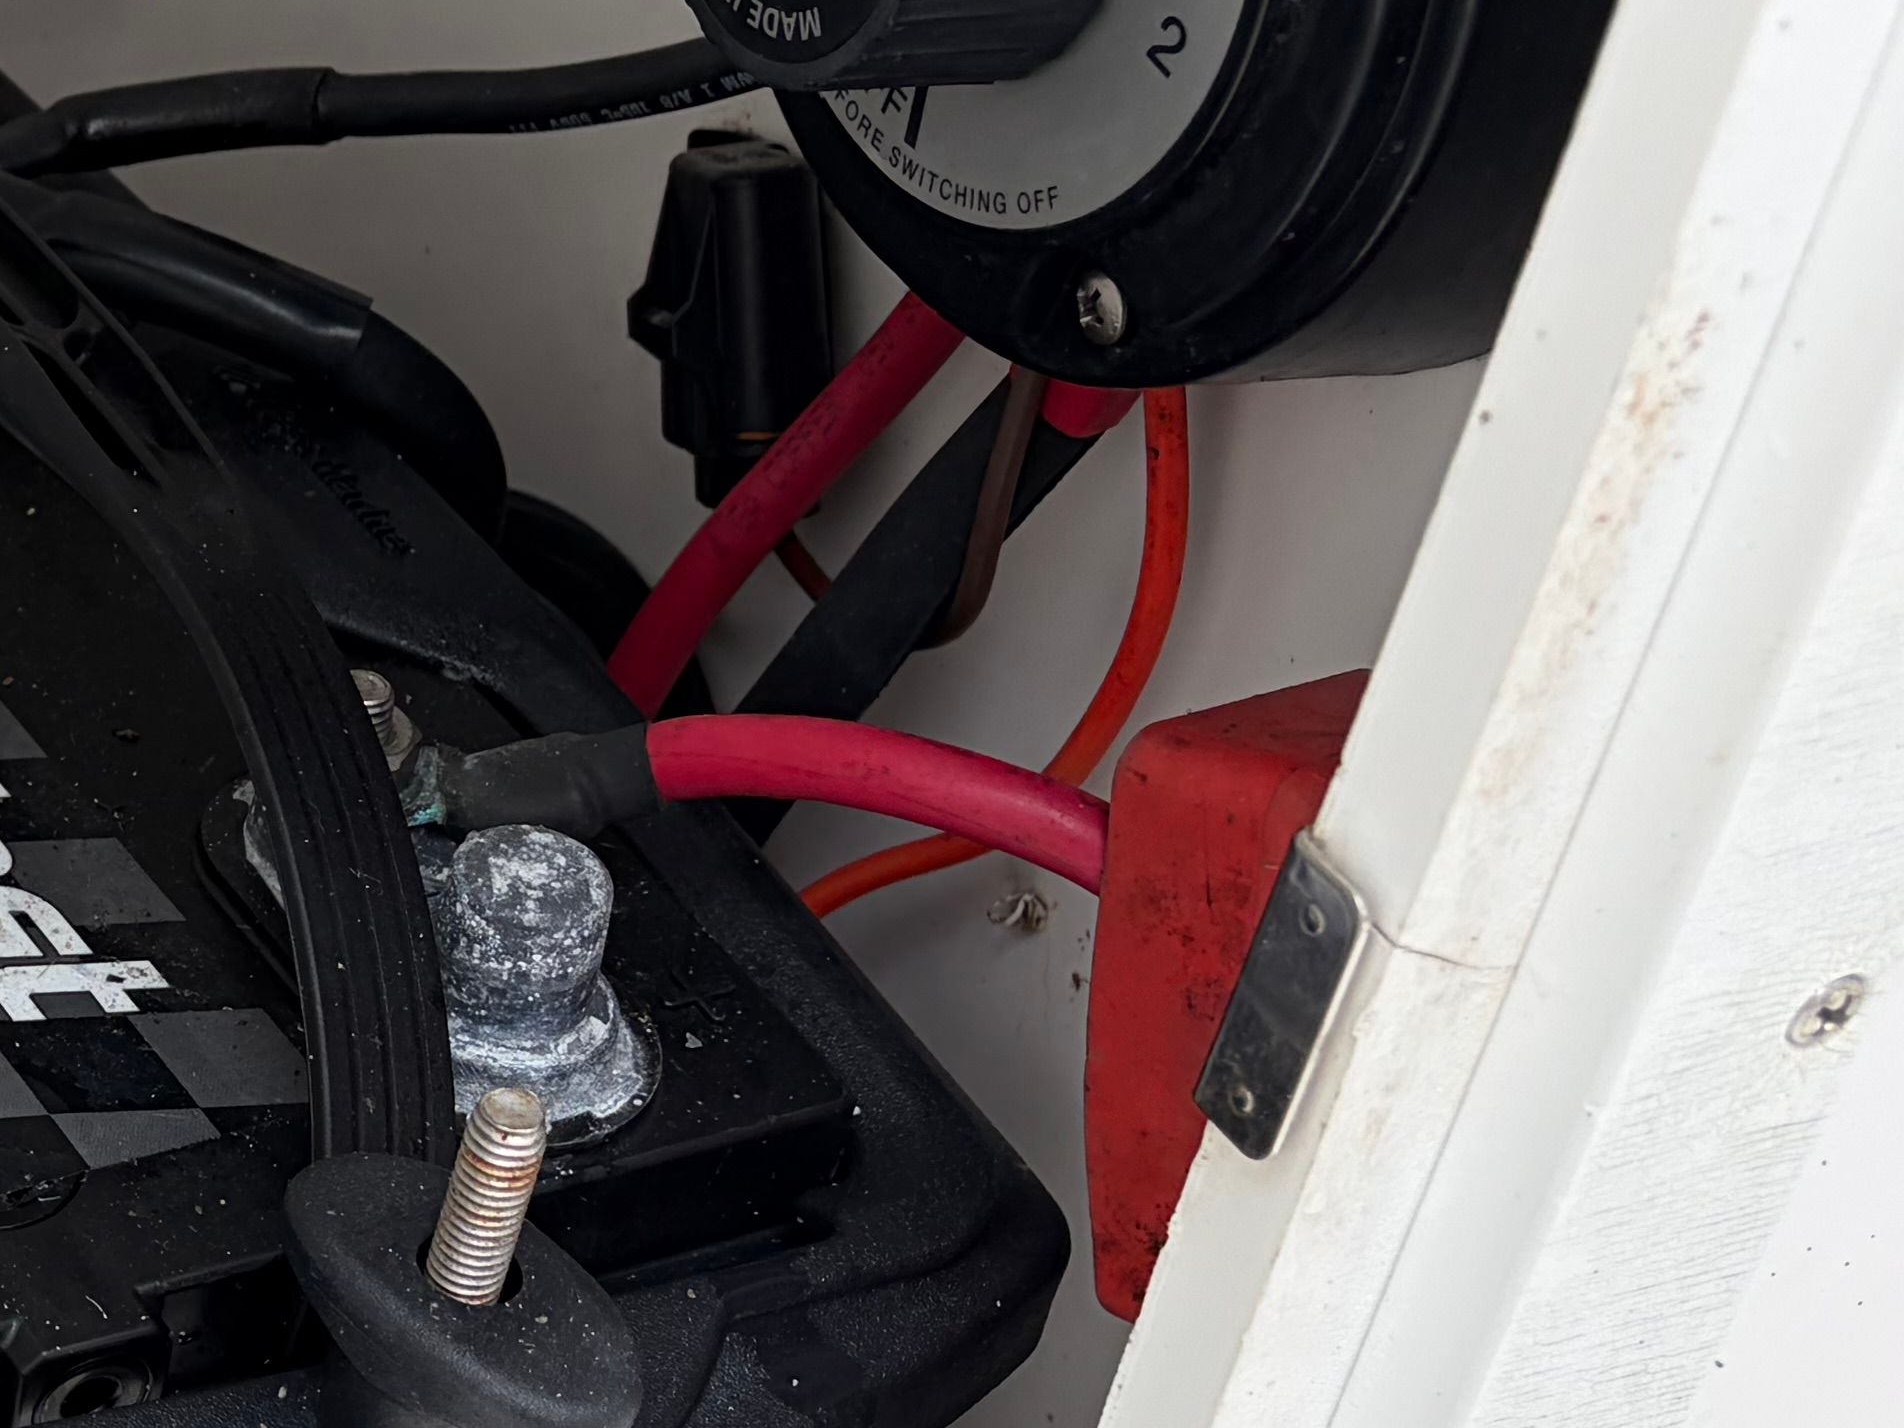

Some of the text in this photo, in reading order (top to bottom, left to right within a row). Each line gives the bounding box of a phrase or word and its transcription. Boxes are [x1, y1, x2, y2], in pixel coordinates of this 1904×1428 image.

[1144, 15, 1189, 78] 2
[888, 146, 1008, 215] SWITCHING
[1016, 185, 1060, 215] OFF
